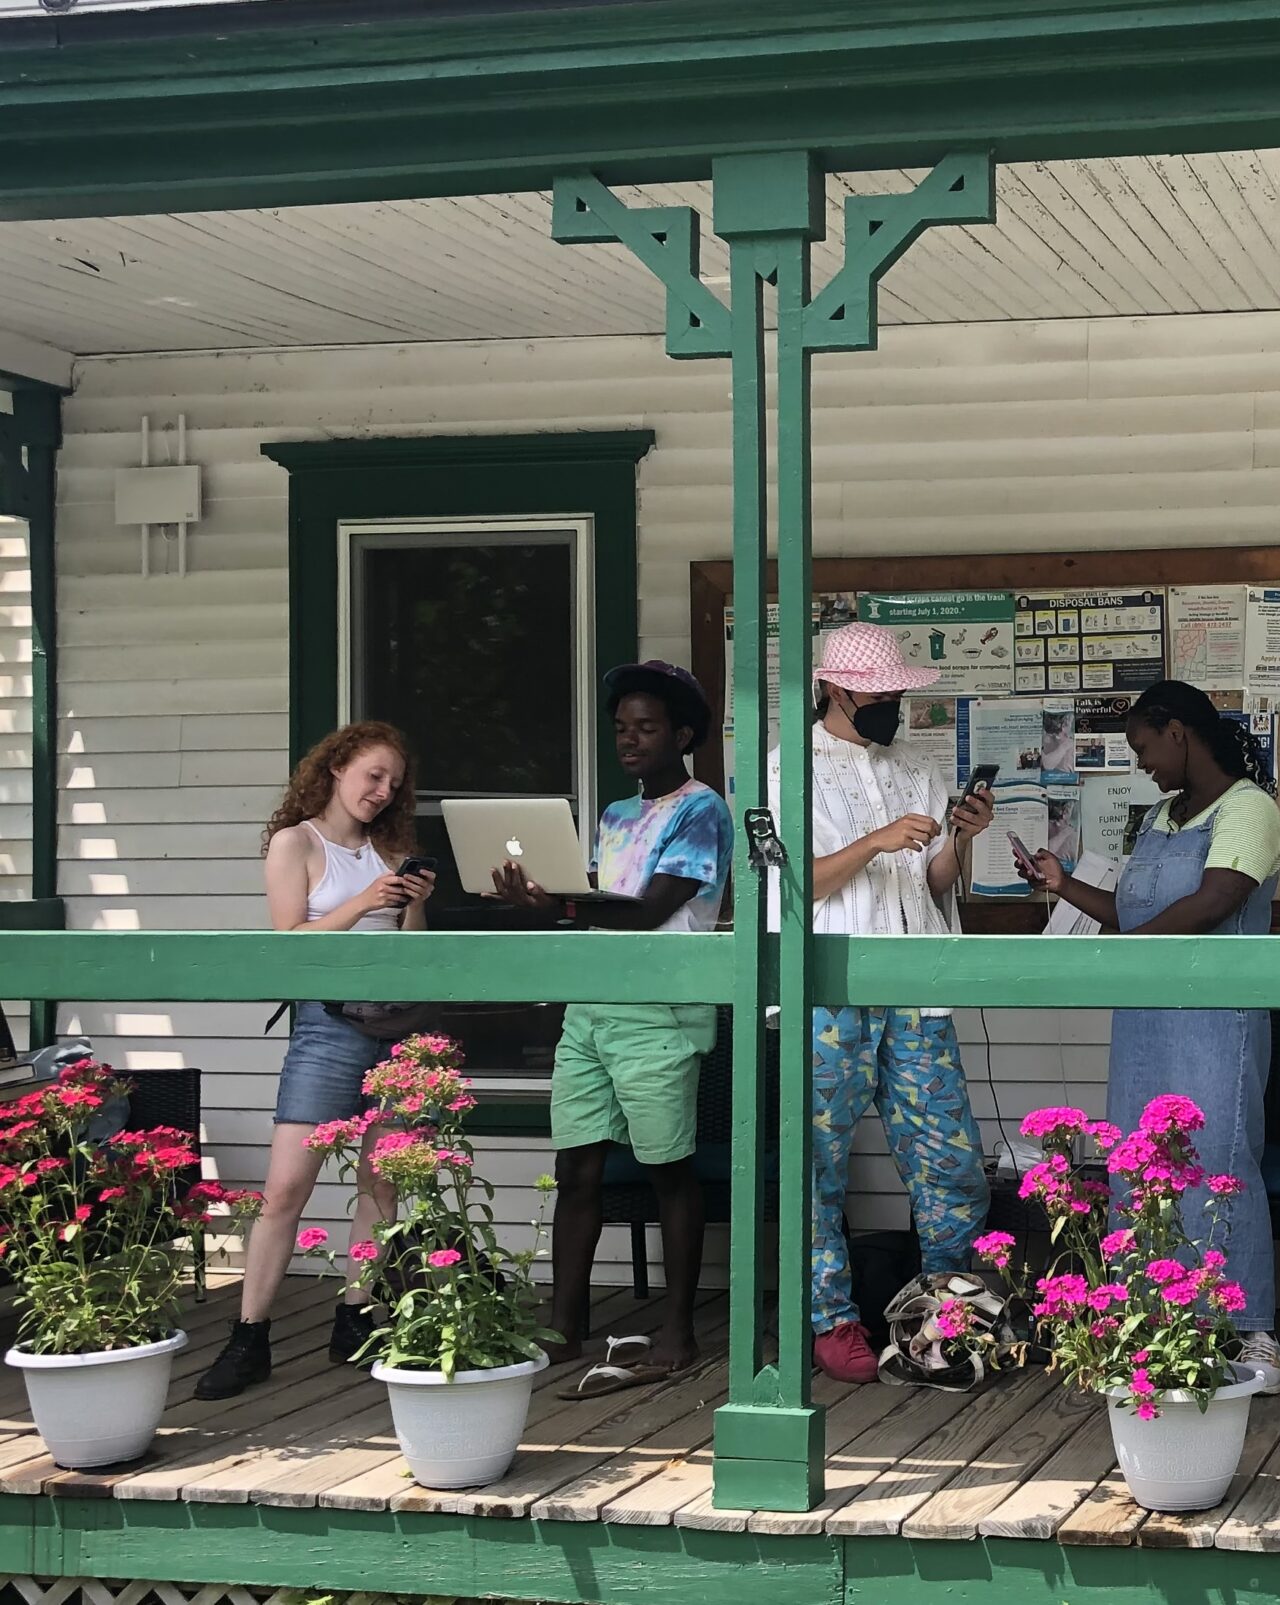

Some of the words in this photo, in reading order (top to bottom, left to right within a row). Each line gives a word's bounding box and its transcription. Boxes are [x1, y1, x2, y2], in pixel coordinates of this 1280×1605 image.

[987, 593, 1005, 601] trash
[1049, 599, 1096, 608] DISPOSAL
[1098, 596, 1124, 606] BANS
[889, 607, 917, 616] starting
[918, 606, 931, 616] July
[932, 608, 939, 616] 1,
[1260, 655, 1277, 663] Apply
[1075, 706, 1112, 714] Powerful
[1107, 787, 1132, 795] ENJOY
[1112, 802, 1128, 810] THE
[1098, 814, 1128, 824] FURNIT
